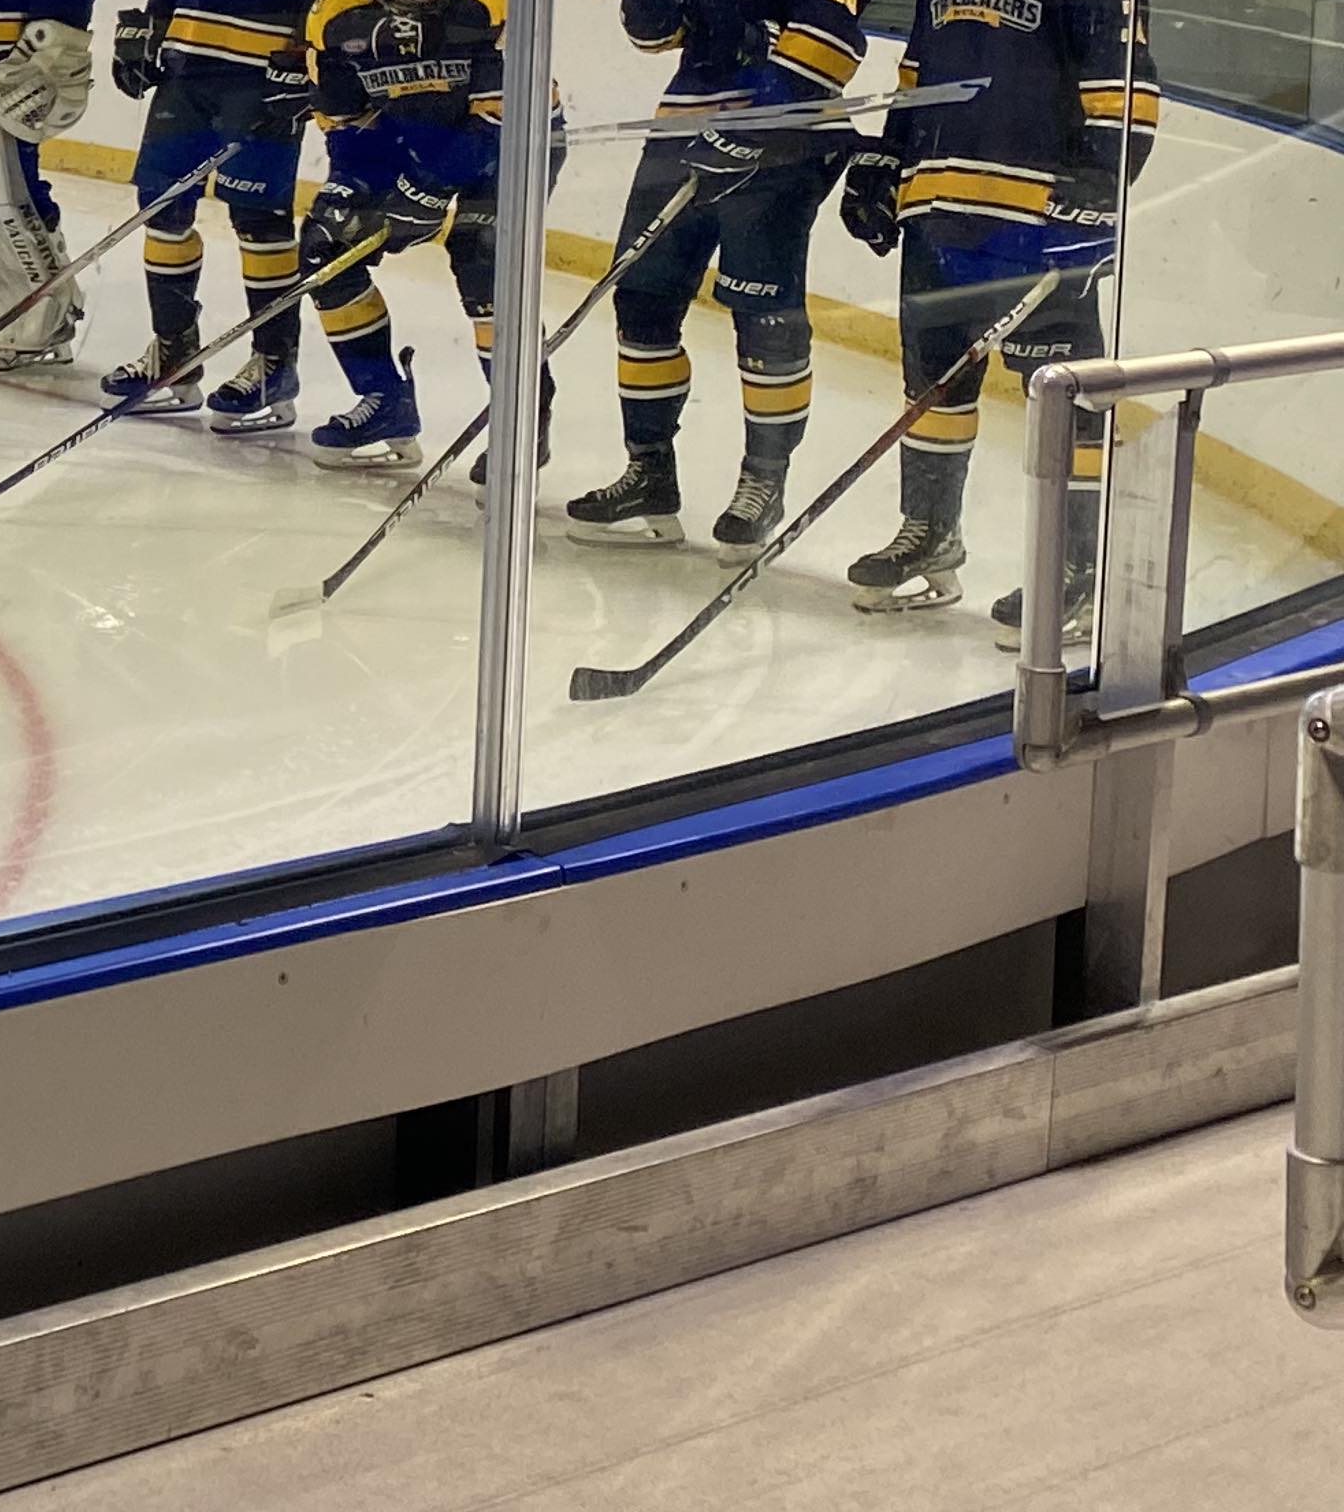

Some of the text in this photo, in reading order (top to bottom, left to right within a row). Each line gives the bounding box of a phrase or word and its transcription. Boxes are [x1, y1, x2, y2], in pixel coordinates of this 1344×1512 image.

[702, 129, 763, 161] AUER
[216, 173, 267, 194] AUER
[396, 178, 448, 211] AUER
[1044, 200, 1118, 227] AUER
[3, 217, 44, 284] VAUGHN
[716, 273, 779, 296] AUER
[1003, 342, 1072, 359] AUER
